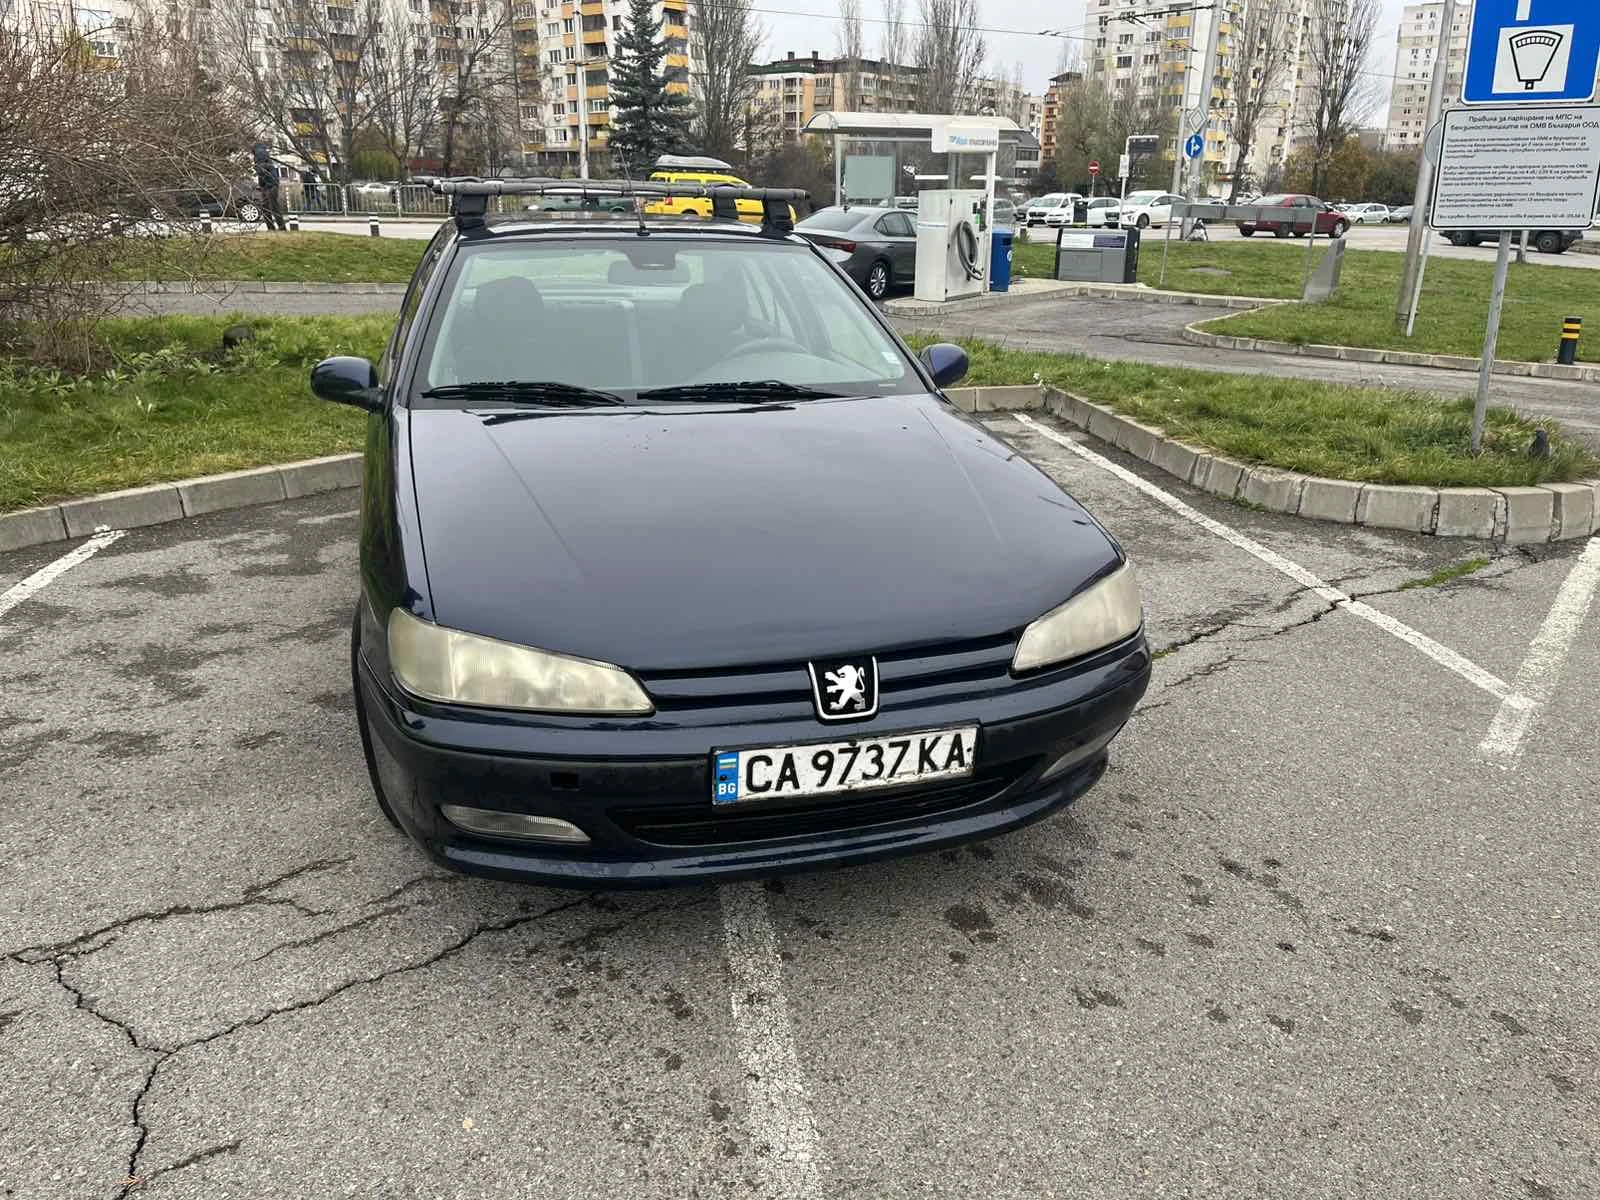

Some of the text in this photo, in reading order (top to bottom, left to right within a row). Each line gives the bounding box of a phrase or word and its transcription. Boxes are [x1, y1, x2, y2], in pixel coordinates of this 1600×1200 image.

[1548, 122, 1581, 130] България
[1582, 121, 1599, 129] ООД
[746, 733, 966, 793] CA 9737 KA
[718, 782, 736, 795] BG
